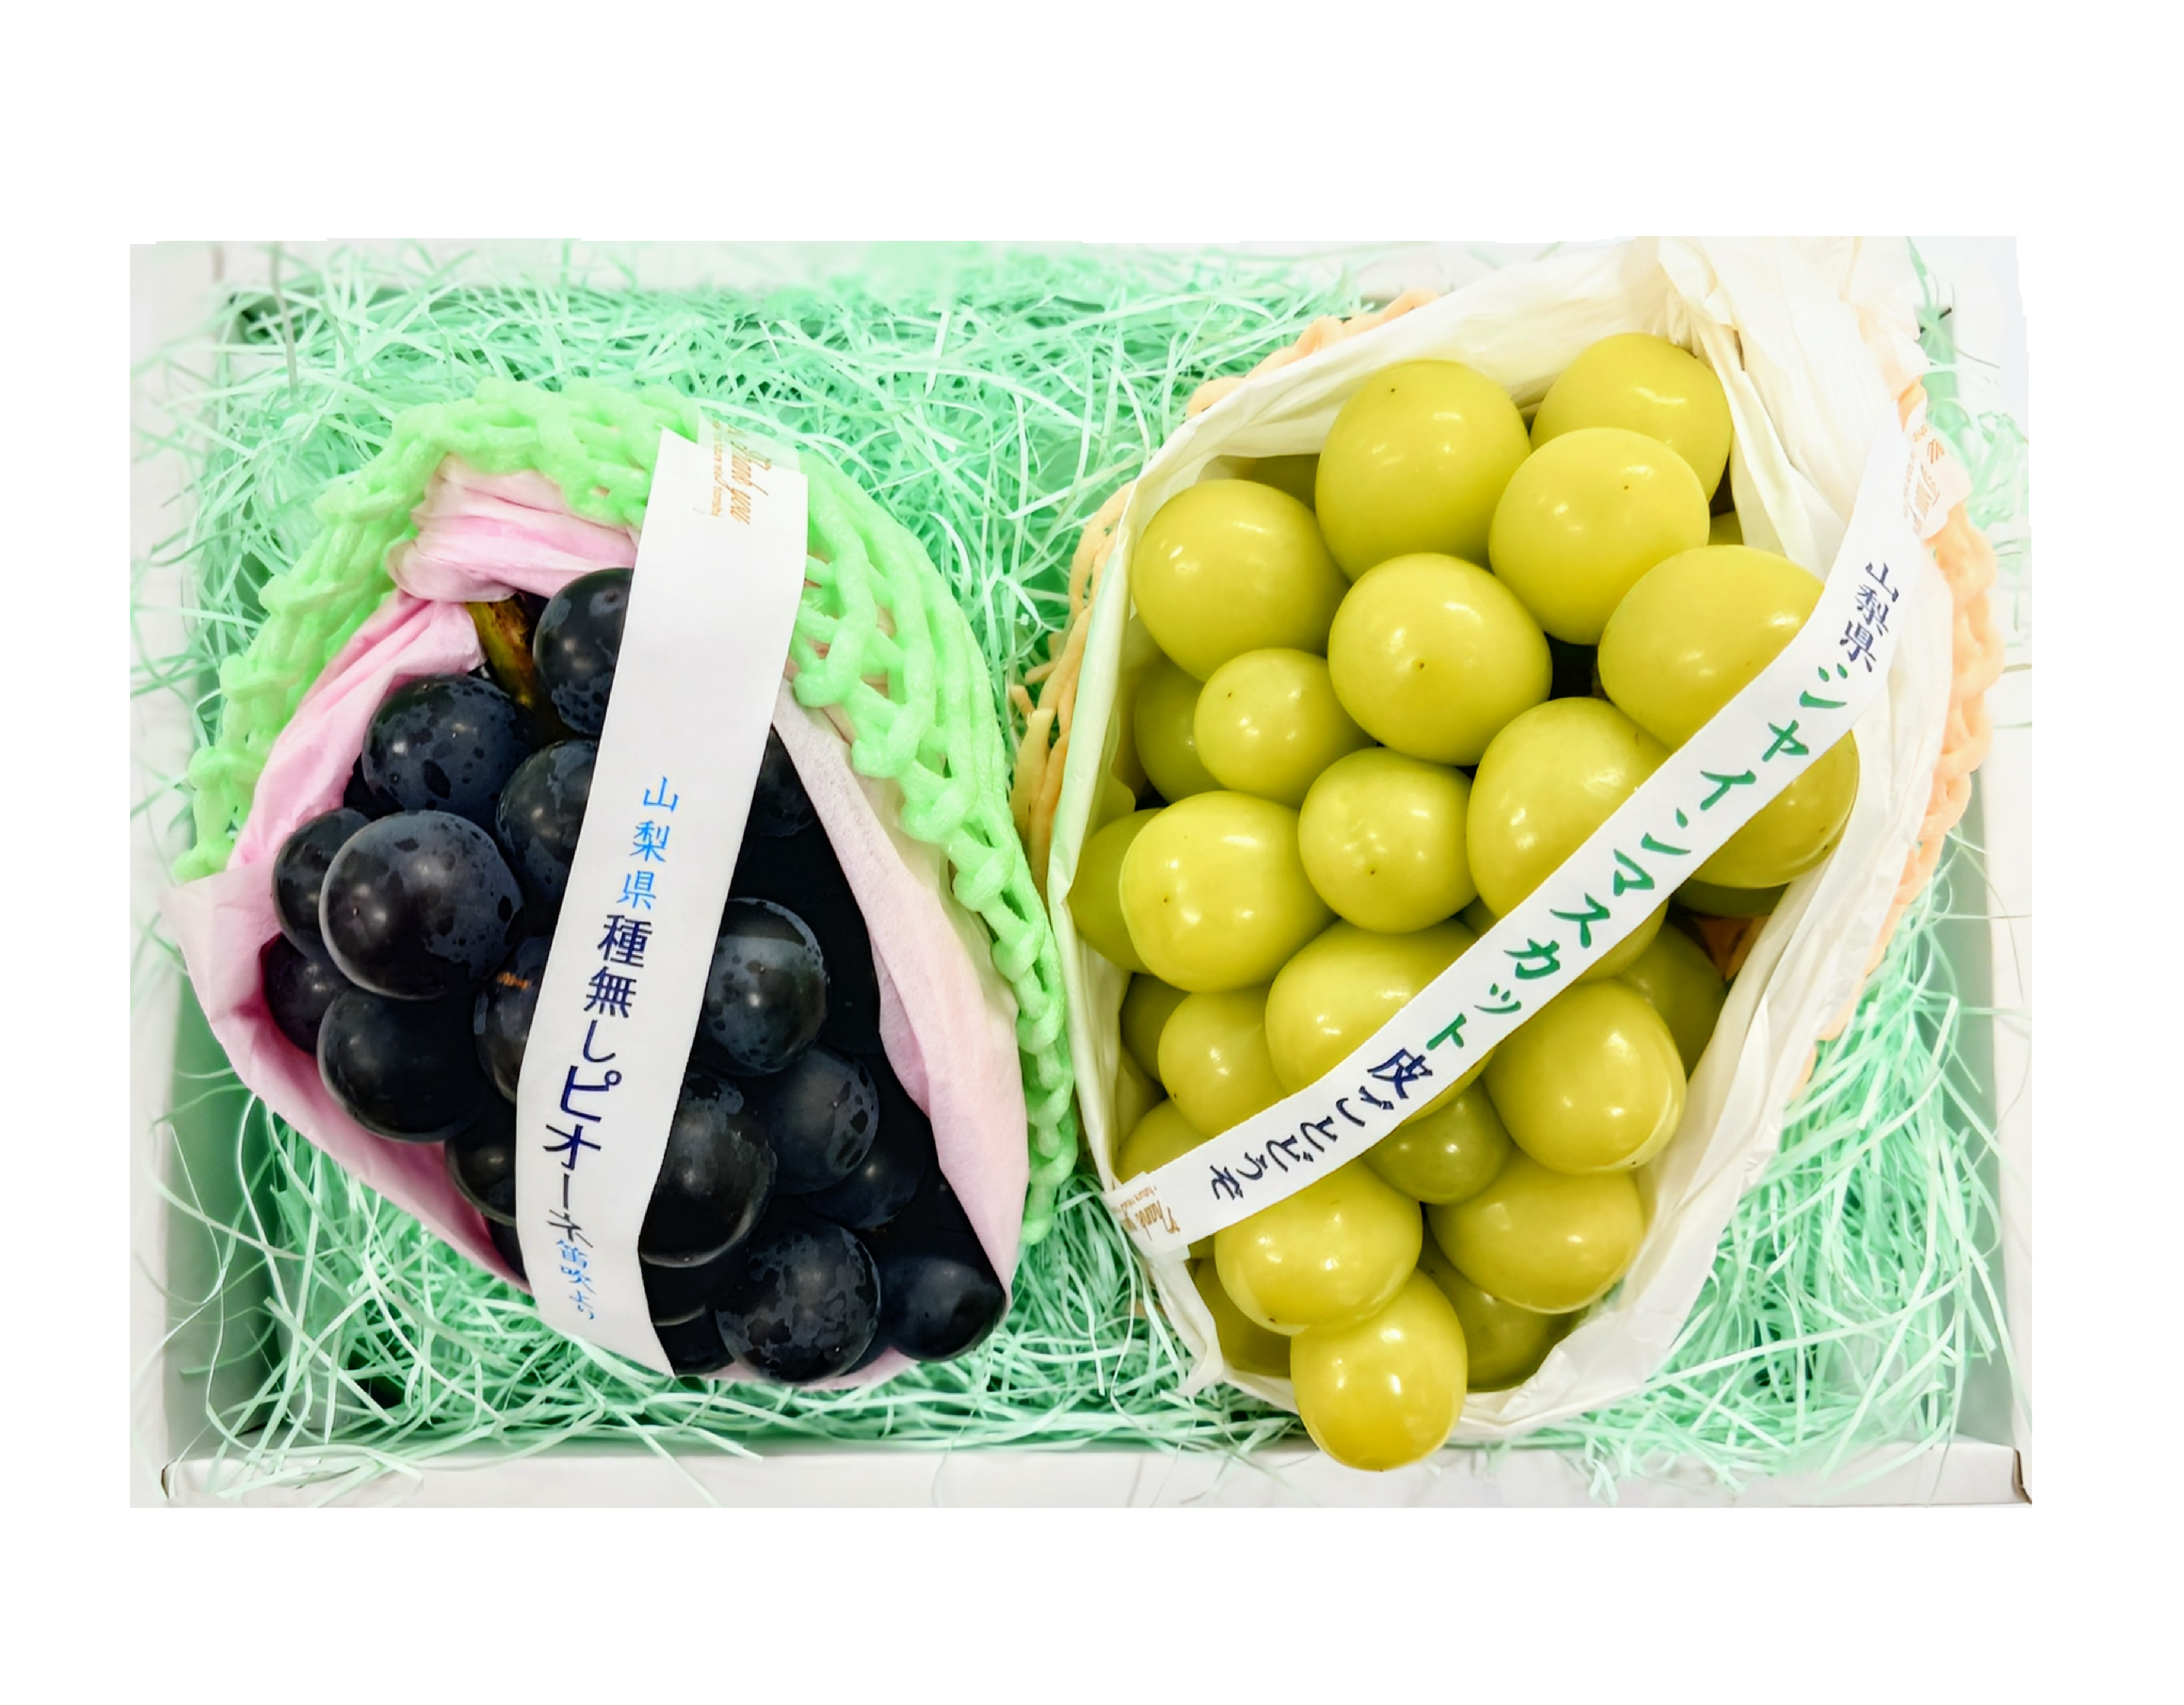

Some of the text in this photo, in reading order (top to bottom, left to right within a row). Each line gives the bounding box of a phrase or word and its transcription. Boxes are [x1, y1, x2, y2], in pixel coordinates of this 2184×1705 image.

[616, 775, 680, 911] 山梨県
[1209, 562, 1899, 1200] 山梨県 シャインマスカット 皮ごとどうぞ
[542, 913, 653, 1248] 種無しピオーネ
